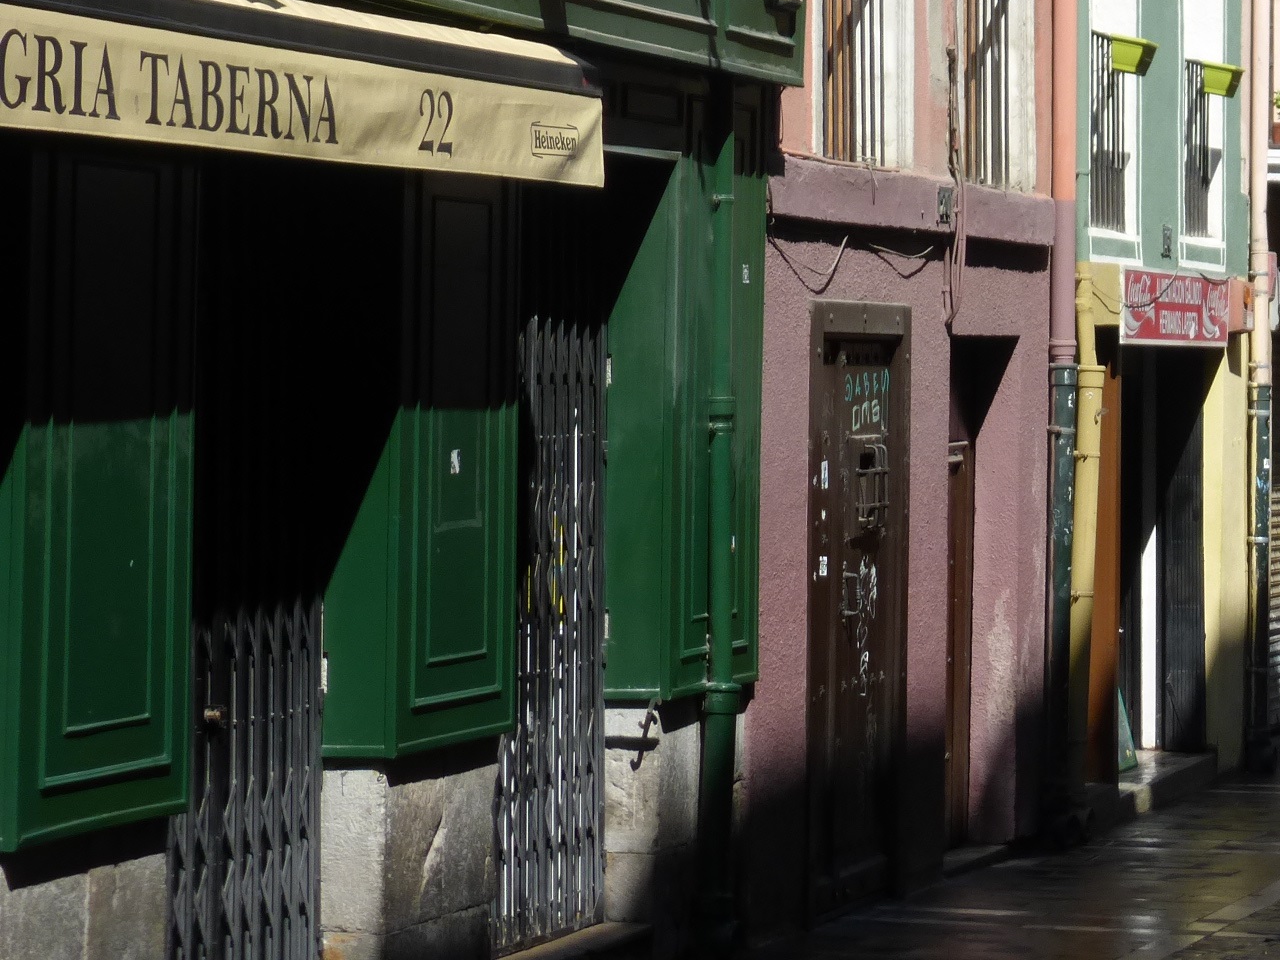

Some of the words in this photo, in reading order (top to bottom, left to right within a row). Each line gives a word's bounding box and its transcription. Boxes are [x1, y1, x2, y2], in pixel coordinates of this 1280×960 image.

[0, 28, 121, 121] GRIA
[140, 50, 339, 145] TABERNA
[418, 88, 454, 158] 22
[533, 128, 577, 152] Heineken
